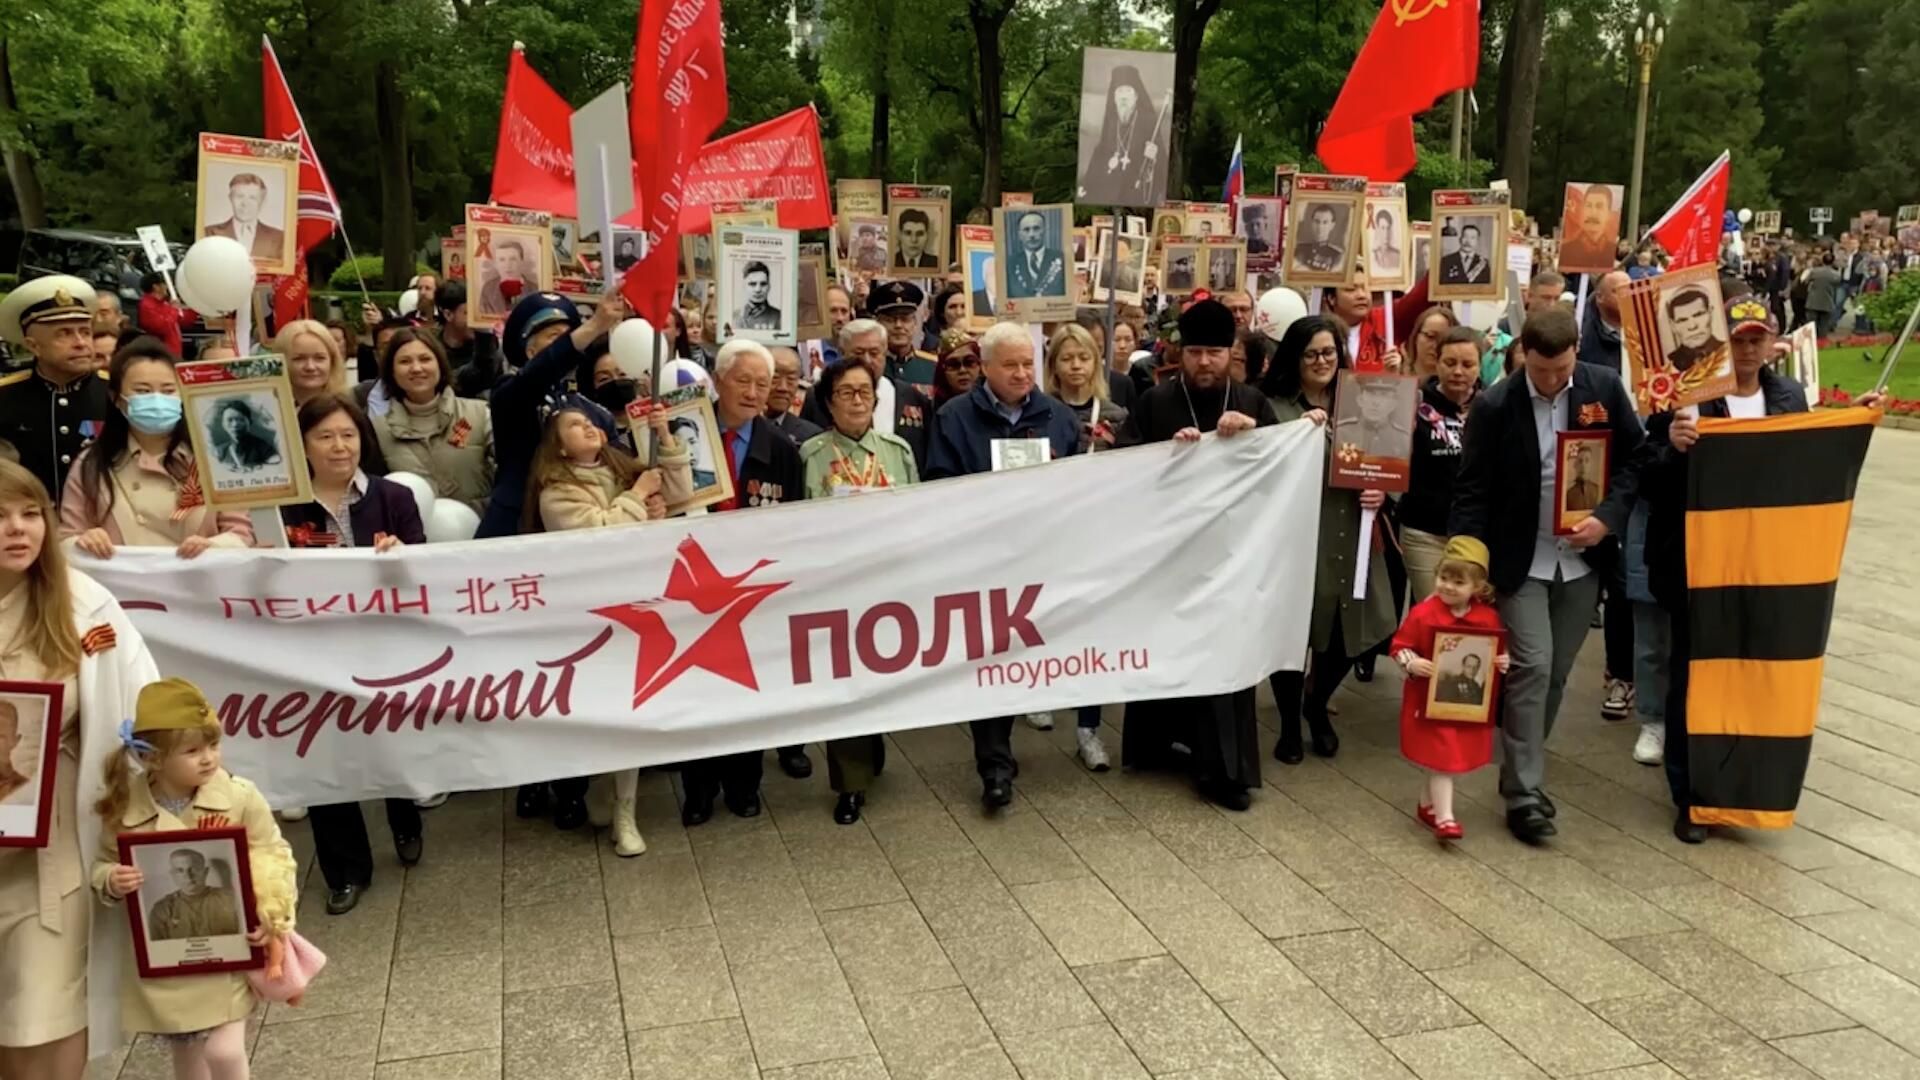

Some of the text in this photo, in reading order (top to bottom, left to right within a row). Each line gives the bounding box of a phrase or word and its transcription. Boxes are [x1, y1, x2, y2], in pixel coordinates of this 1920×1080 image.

[220, 584, 430, 619] ПЕКИН
[455, 573, 546, 615] 北京
[788, 583, 1046, 686] ПОЛК
[977, 646, 1149, 691] moypolk.ru
